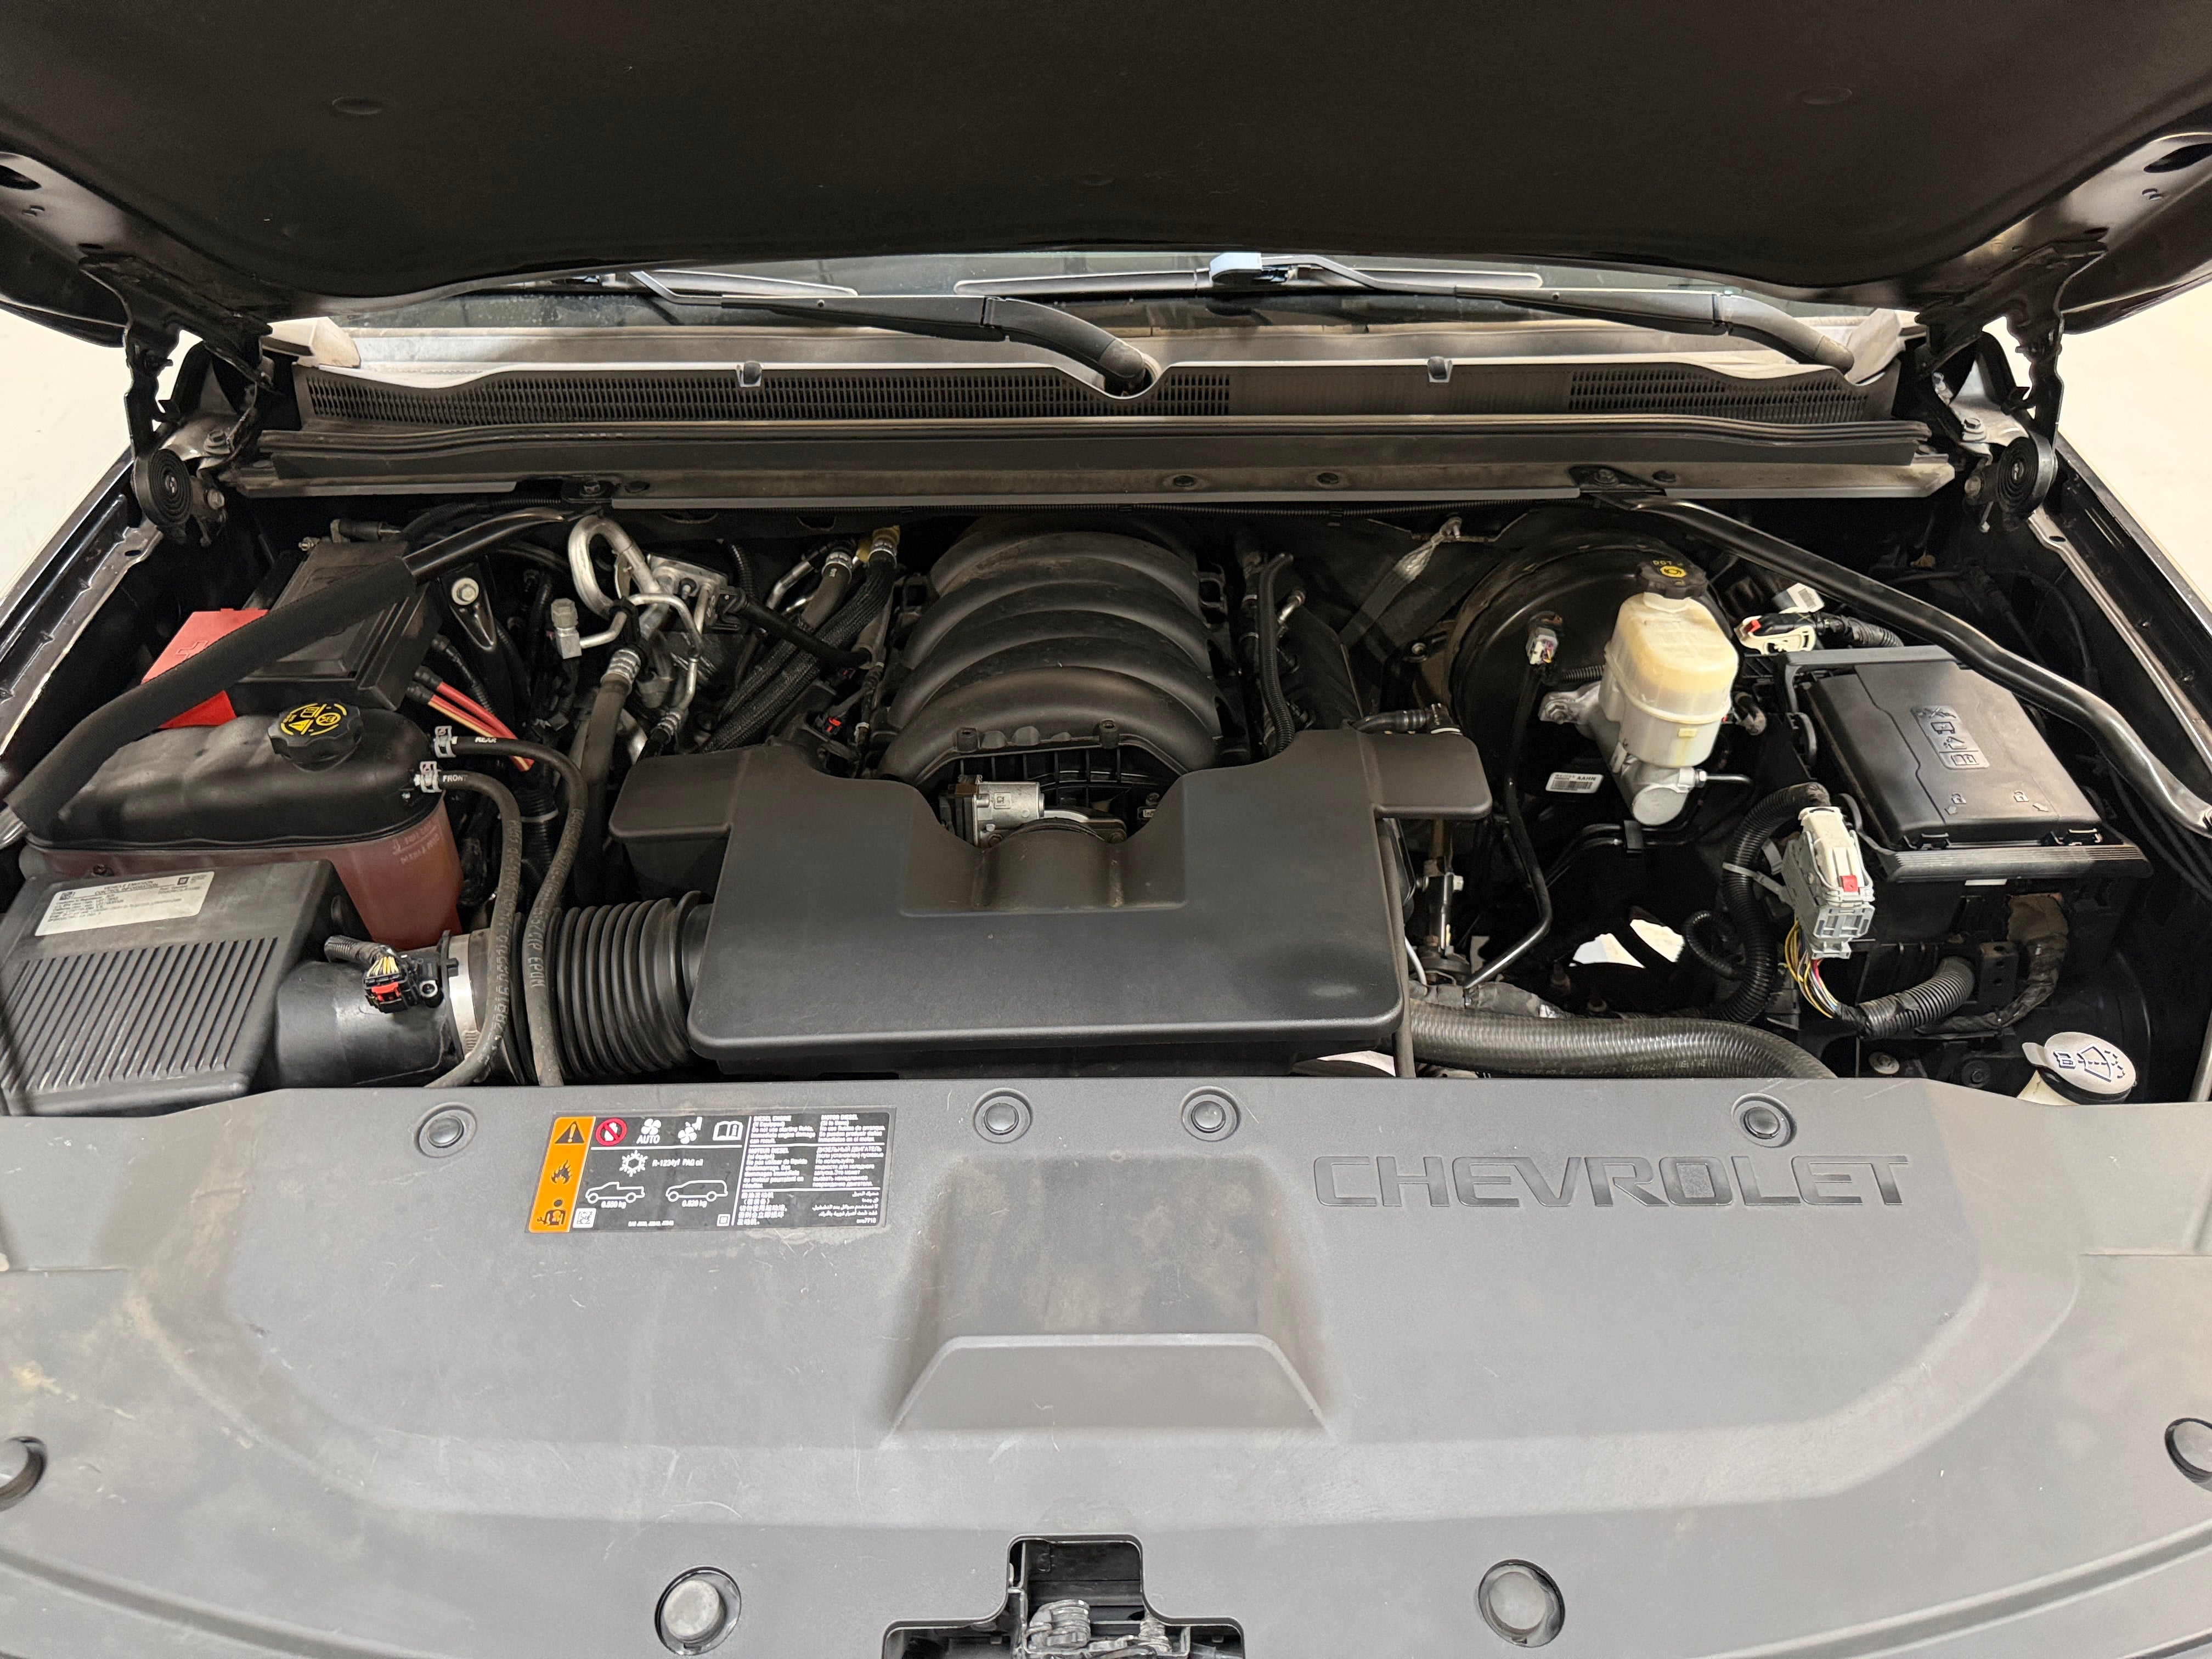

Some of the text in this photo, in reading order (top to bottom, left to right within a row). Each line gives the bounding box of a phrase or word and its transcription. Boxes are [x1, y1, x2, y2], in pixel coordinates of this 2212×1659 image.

[443, 774, 467, 782] FRONT
[636, 1135, 661, 1144] AUTO
[1313, 1155, 1908, 1207] CHEVROLET
